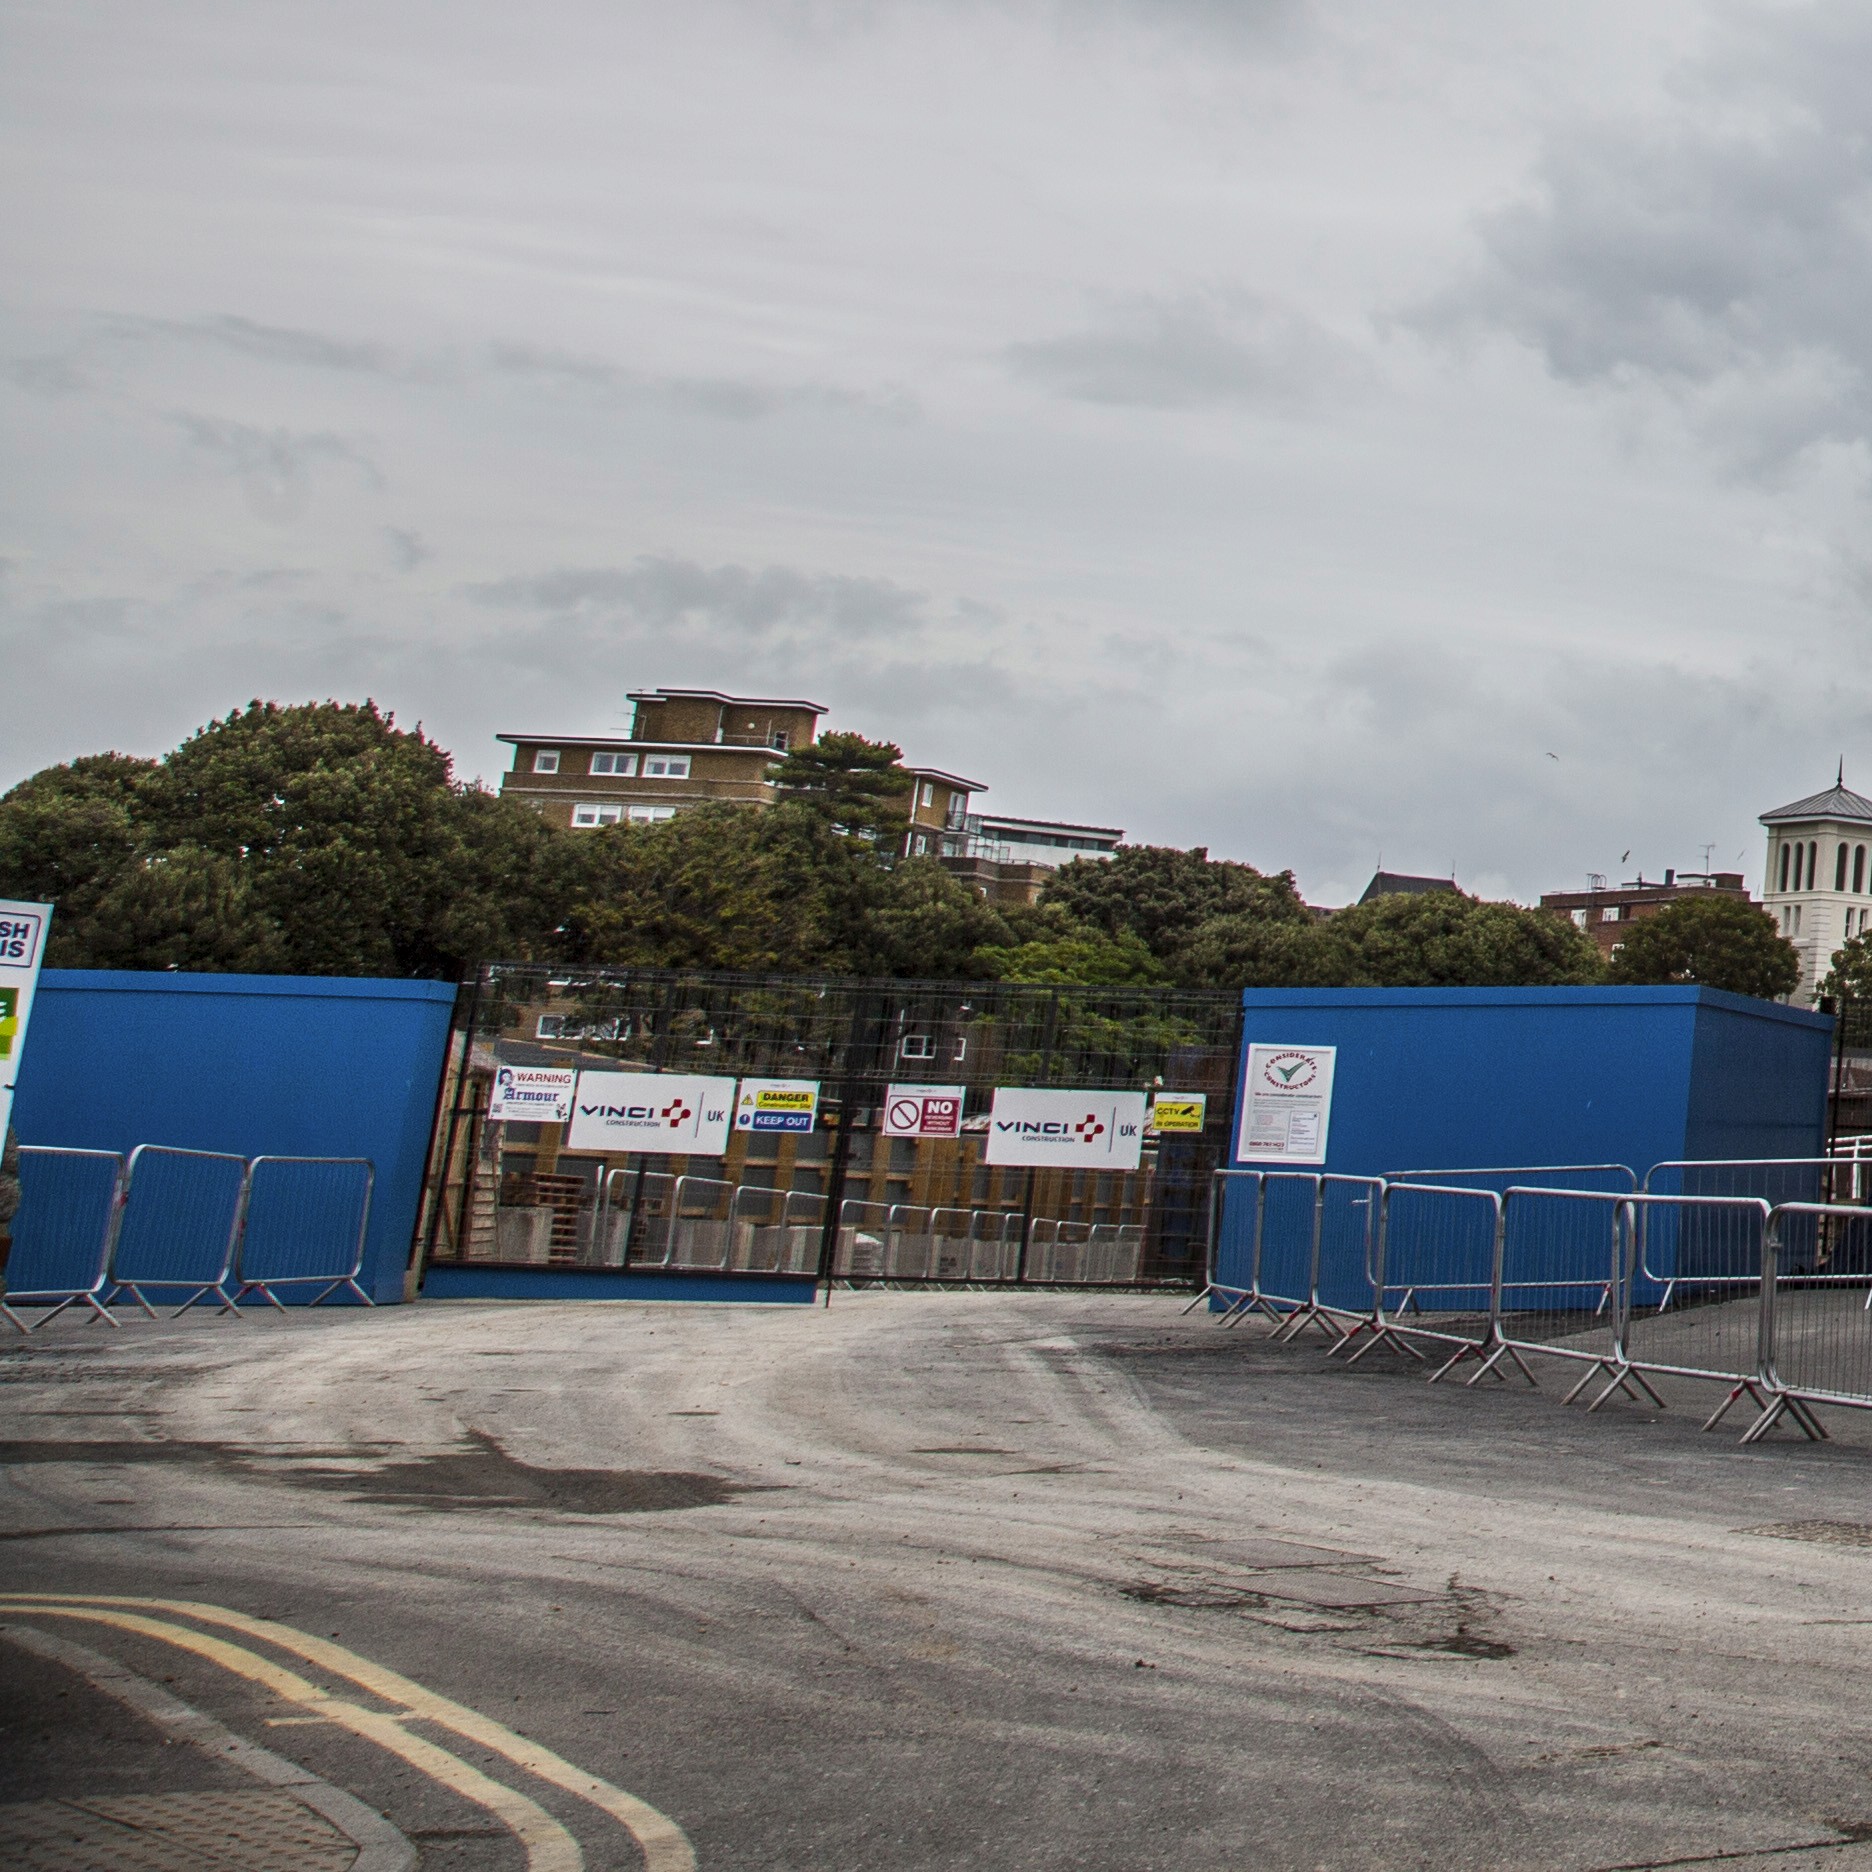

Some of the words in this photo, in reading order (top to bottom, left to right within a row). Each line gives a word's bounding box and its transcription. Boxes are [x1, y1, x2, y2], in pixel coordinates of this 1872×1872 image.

[1265, 1052, 1317, 1070] CONSIDERATE
[516, 1072, 572, 1084] WARNING
[1264, 1071, 1316, 1090] CONSTRUCTORS
[502, 1086, 560, 1102] Armour
[763, 1092, 809, 1102] DANGER
[580, 1105, 655, 1119] VINCI
[707, 1109, 725, 1122] UK
[927, 1100, 953, 1115] NO
[1156, 1107, 1180, 1116] CCTV
[605, 1119, 661, 1128] CONSTRUCTION
[755, 1115, 785, 1125] KEEP
[785, 1116, 809, 1126] OUT
[997, 1121, 1069, 1135] VINCI
[1120, 1124, 1138, 1137] UK
[1021, 1135, 1076, 1143] CONSTRUCTION
